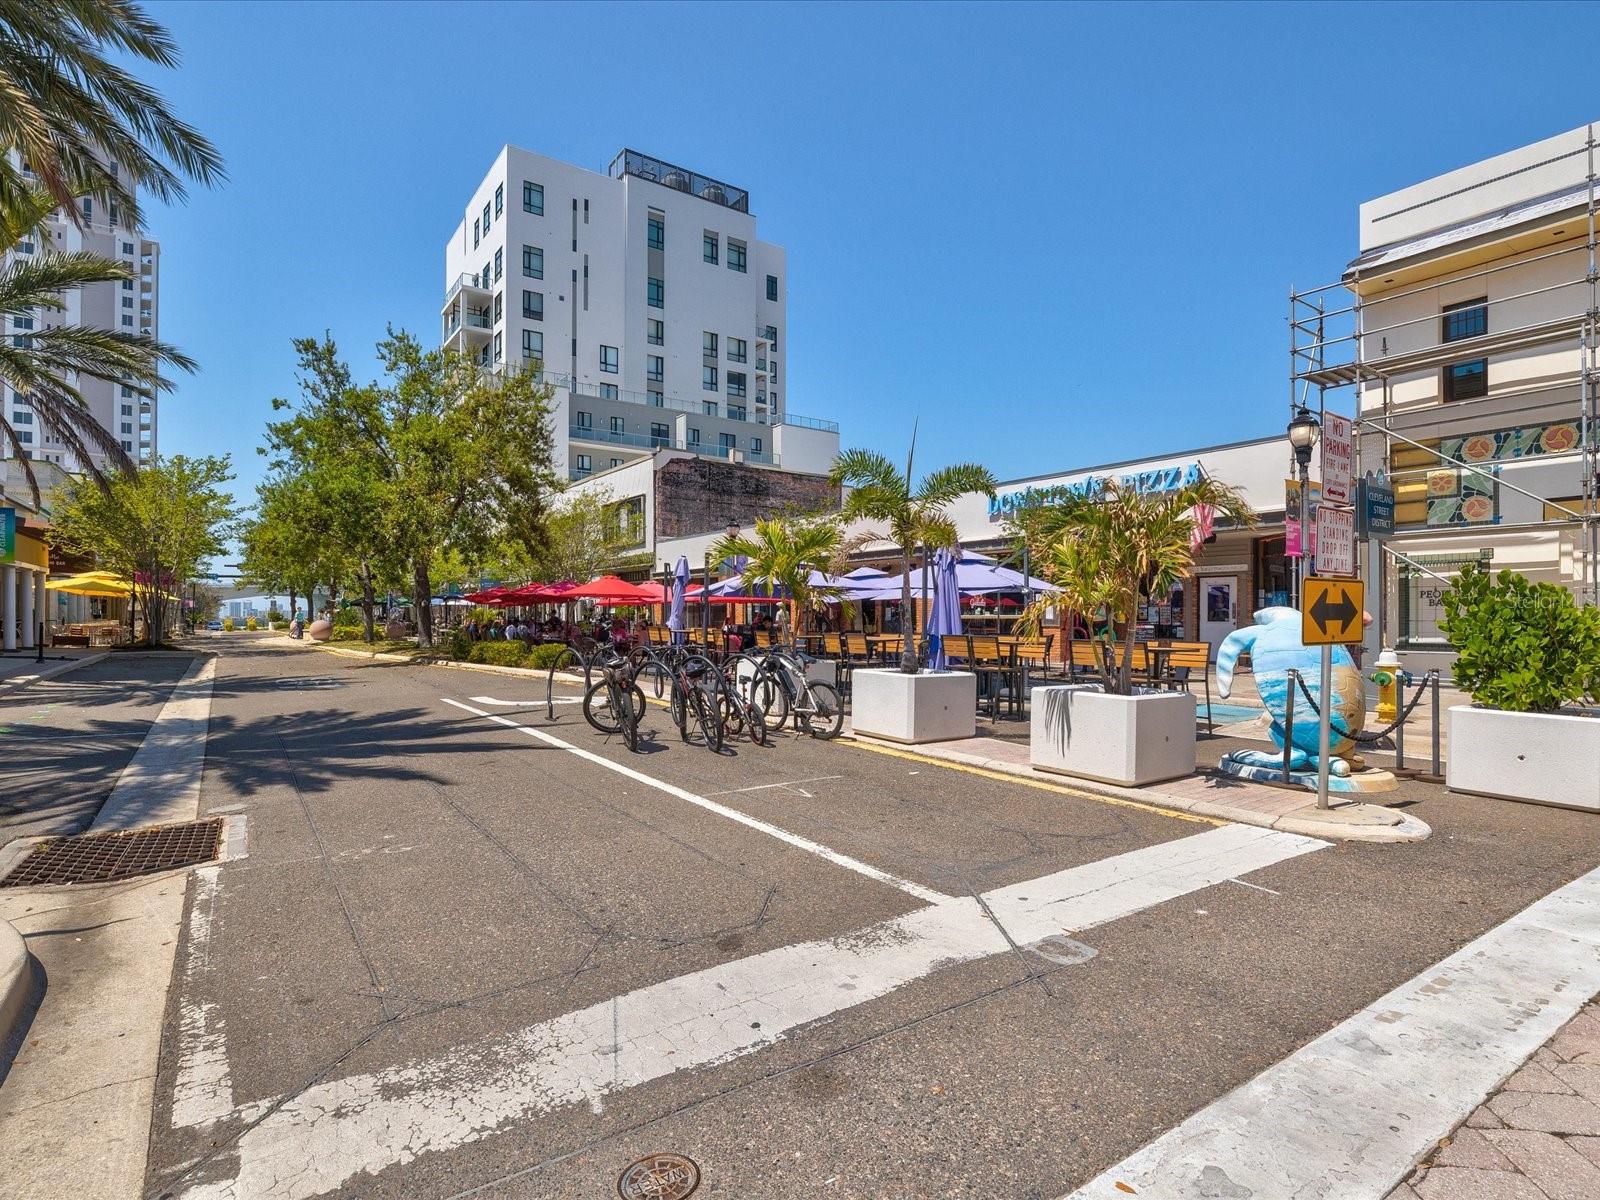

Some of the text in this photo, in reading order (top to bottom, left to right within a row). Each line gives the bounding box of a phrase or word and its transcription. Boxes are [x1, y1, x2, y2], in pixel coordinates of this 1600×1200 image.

[1332, 420, 1344, 437] NO
[1325, 437, 1351, 459] PARKING
[1337, 460, 1349, 473] LANE
[1121, 463, 1199, 496] PIZZA
[1369, 492, 1393, 505] CLEVELAND
[1373, 505, 1390, 516] STREET
[1319, 510, 1352, 527] NO STOPPING
[1371, 517, 1391, 529] DISTRICT
[1323, 526, 1348, 542] STANDING
[1322, 541, 1349, 556] DROP OFF
[1322, 557, 1348, 571] ANY TIME
[629, 1166, 687, 1196] WATER
